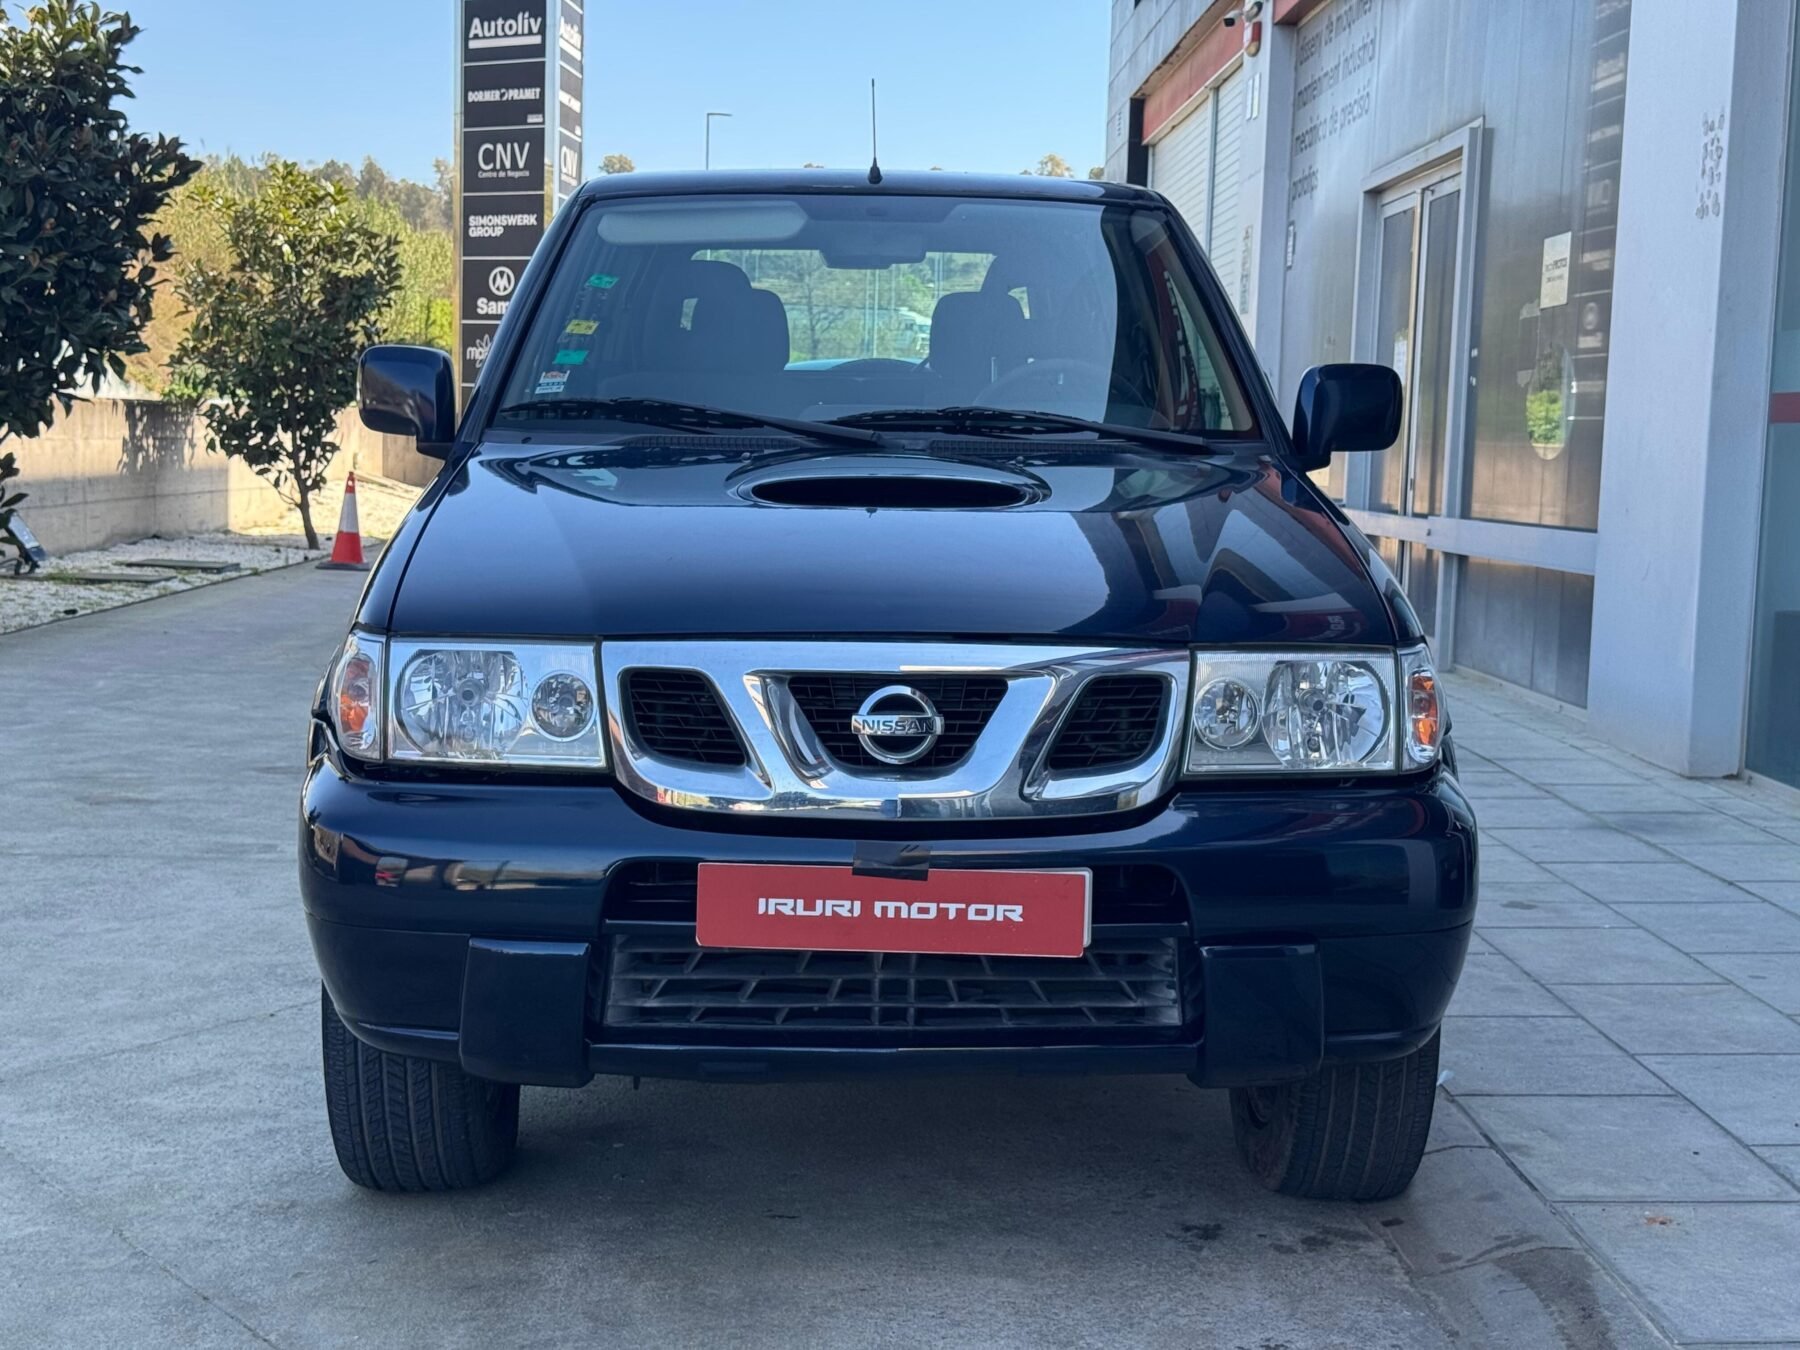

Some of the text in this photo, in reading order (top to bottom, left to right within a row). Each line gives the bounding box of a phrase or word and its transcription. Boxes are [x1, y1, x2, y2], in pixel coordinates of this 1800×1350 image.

[469, 11, 542, 38] Autoliv
[478, 141, 530, 170] CNV
[469, 213, 538, 227] SIMONSWERK
[469, 226, 505, 238] GROUP
[862, 719, 935, 733] NISSAN
[758, 897, 1024, 922] IRURI MOTOR
